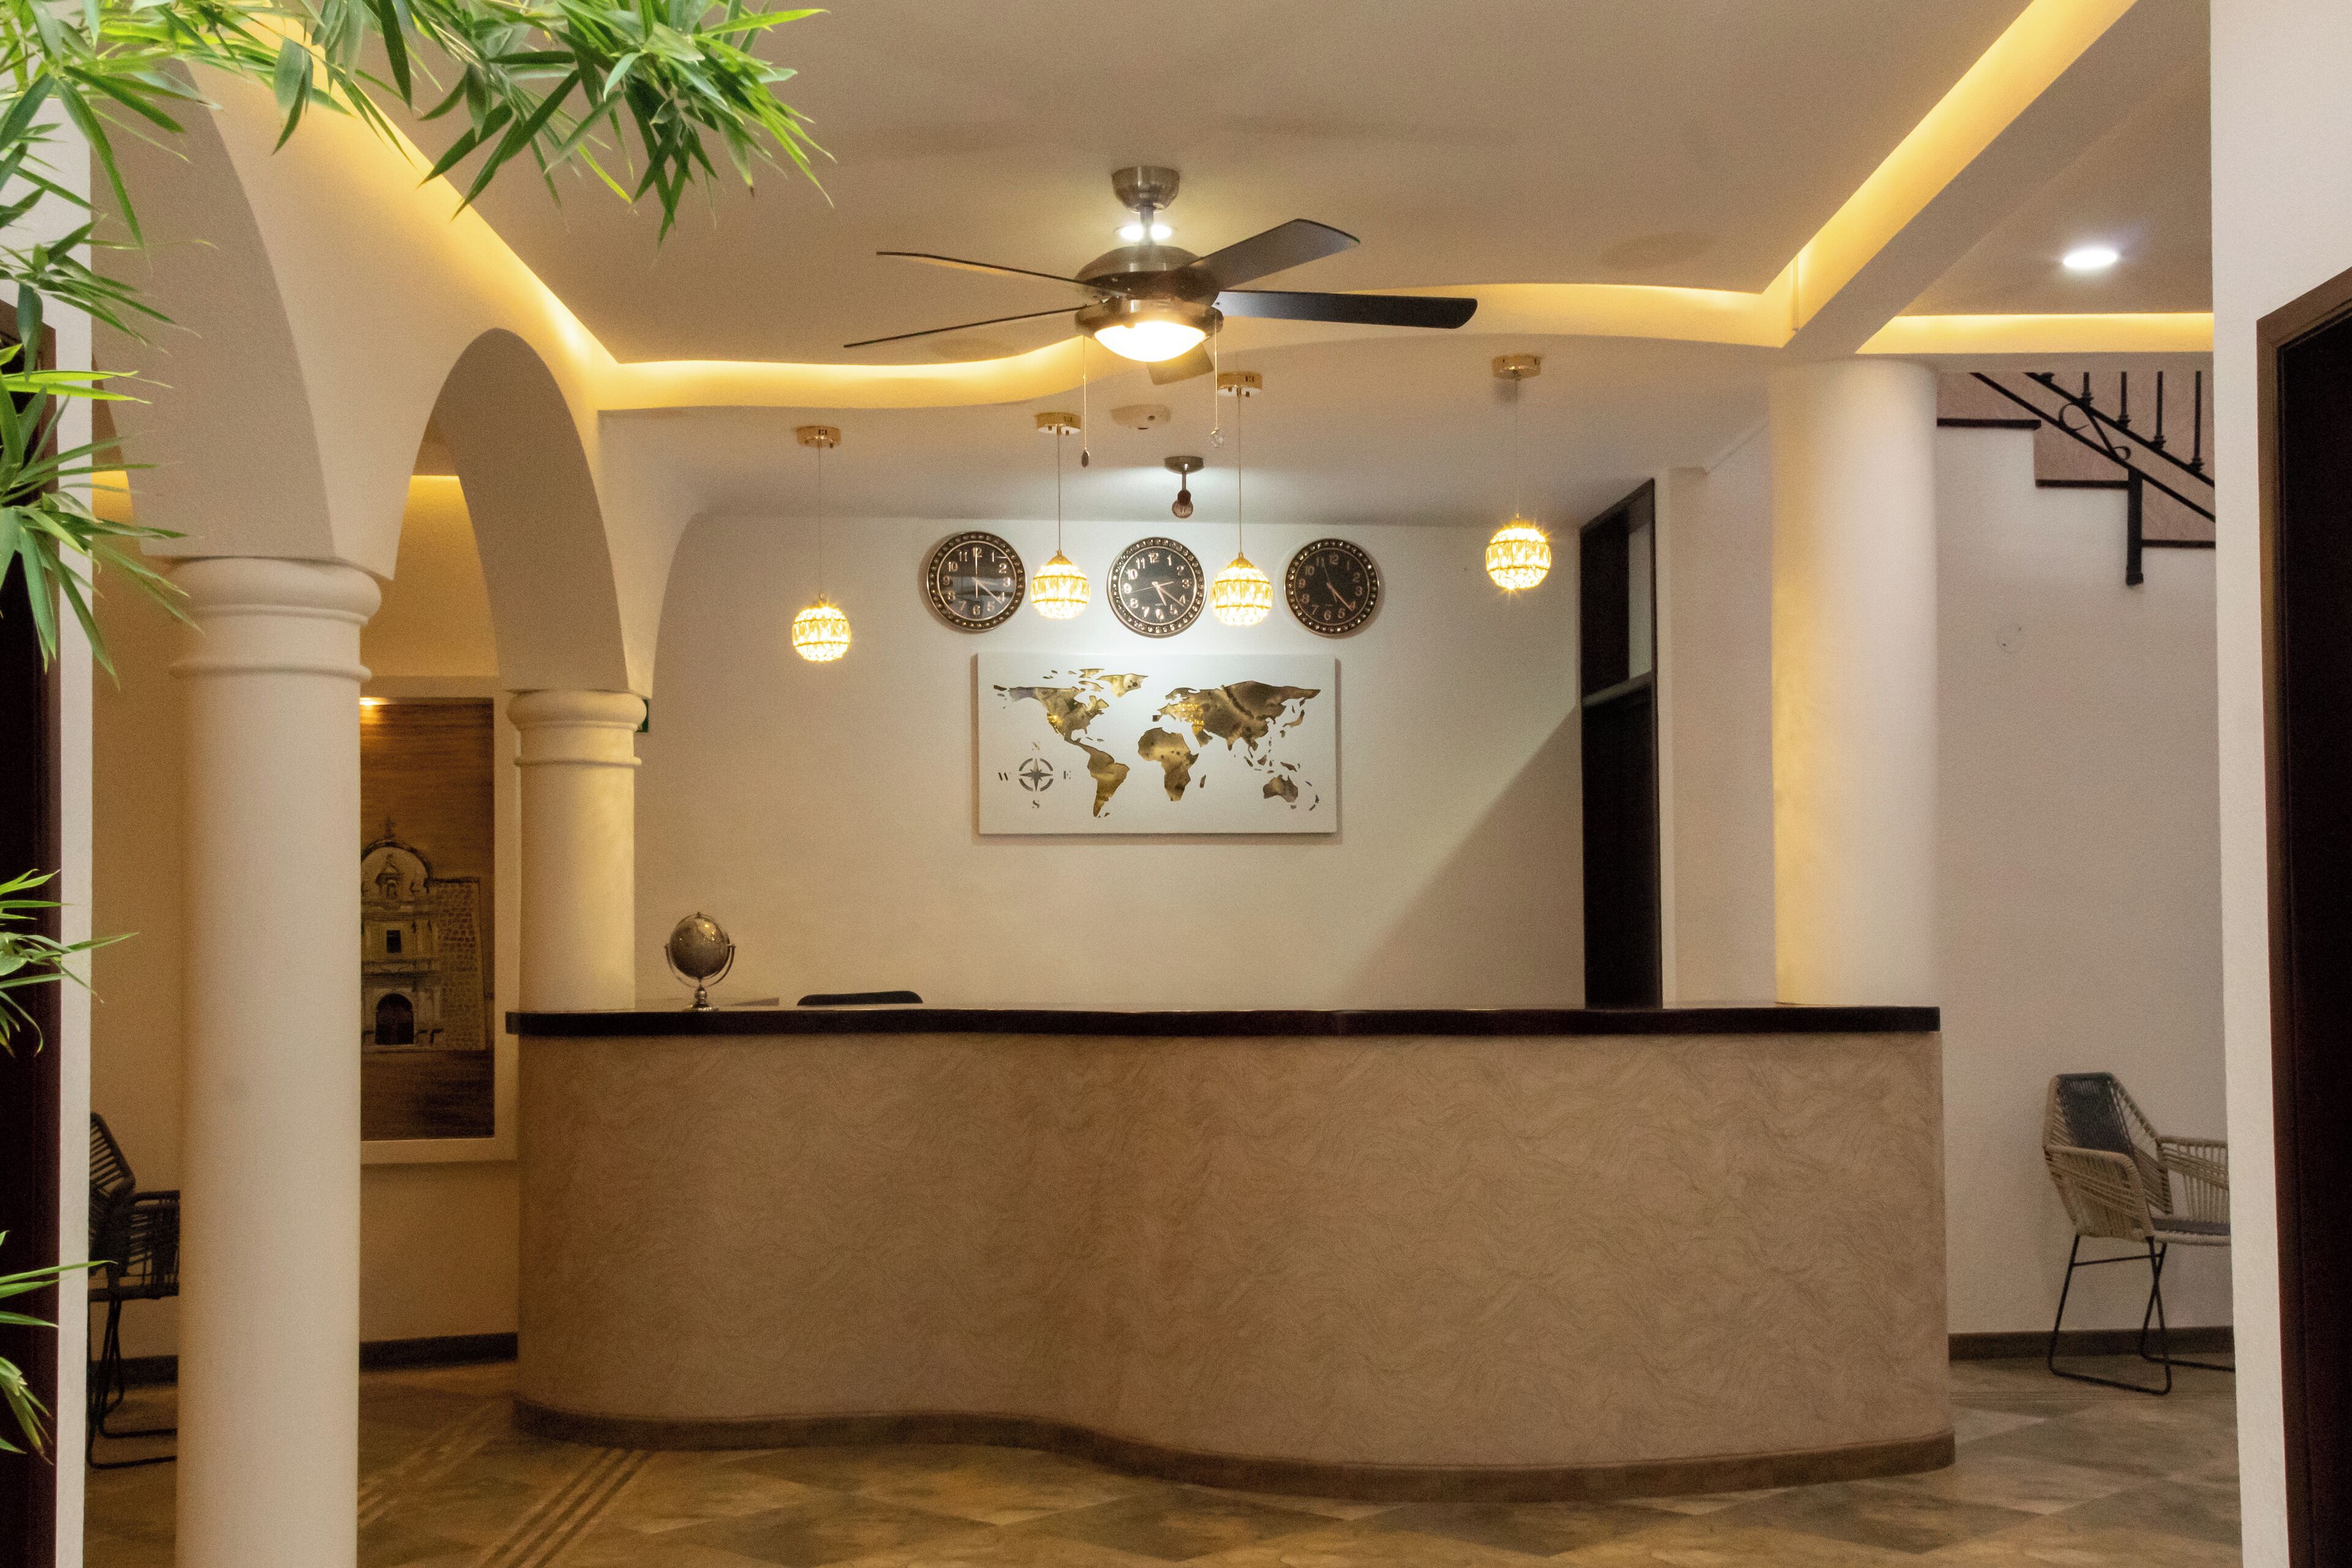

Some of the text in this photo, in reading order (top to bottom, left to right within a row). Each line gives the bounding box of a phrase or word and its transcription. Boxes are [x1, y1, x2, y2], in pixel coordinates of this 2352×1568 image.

[959, 551, 967, 562] 11
[973, 547, 982, 557] 12
[992, 551, 994, 562] 1
[1148, 552, 1159, 563] 12
[1167, 555, 1172, 566] 1
[1316, 557, 1324, 568] 11
[1329, 554, 1339, 565] 12
[949, 562, 958, 571] 10
[998, 563, 1006, 573] 2
[1136, 557, 1145, 569] 11
[1347, 561, 1349, 570] 1
[1126, 569, 1137, 580] 10
[1177, 565, 1186, 576] 2
[1305, 566, 1314, 576] 10
[943, 575, 950, 586] 9
[1003, 577, 1010, 587] 3
[1353, 572, 1360, 582] 2
[1182, 579, 1189, 588] 3
[1298, 578, 1305, 588] 9
[1123, 583, 1132, 594] 9
[1355, 586, 1362, 596] 3
[949, 591, 956, 601] 8
[998, 592, 1005, 602] 4
[1302, 594, 1310, 603] 8
[959, 601, 967, 611] 7
[987, 601, 995, 611] 5
[1130, 598, 1138, 608] 8
[1348, 601, 1355, 611] 4
[973, 605, 980, 616] 6
[1142, 606, 1150, 617] 7
[1156, 609, 1164, 620] 6
[1170, 605, 1178, 615] 5
[1312, 605, 1319, 615] 7
[1324, 610, 1331, 620] 6
[1338, 608, 1345, 619] 5
[1063, 771, 1071, 780] E
[1032, 800, 1040, 809] S
